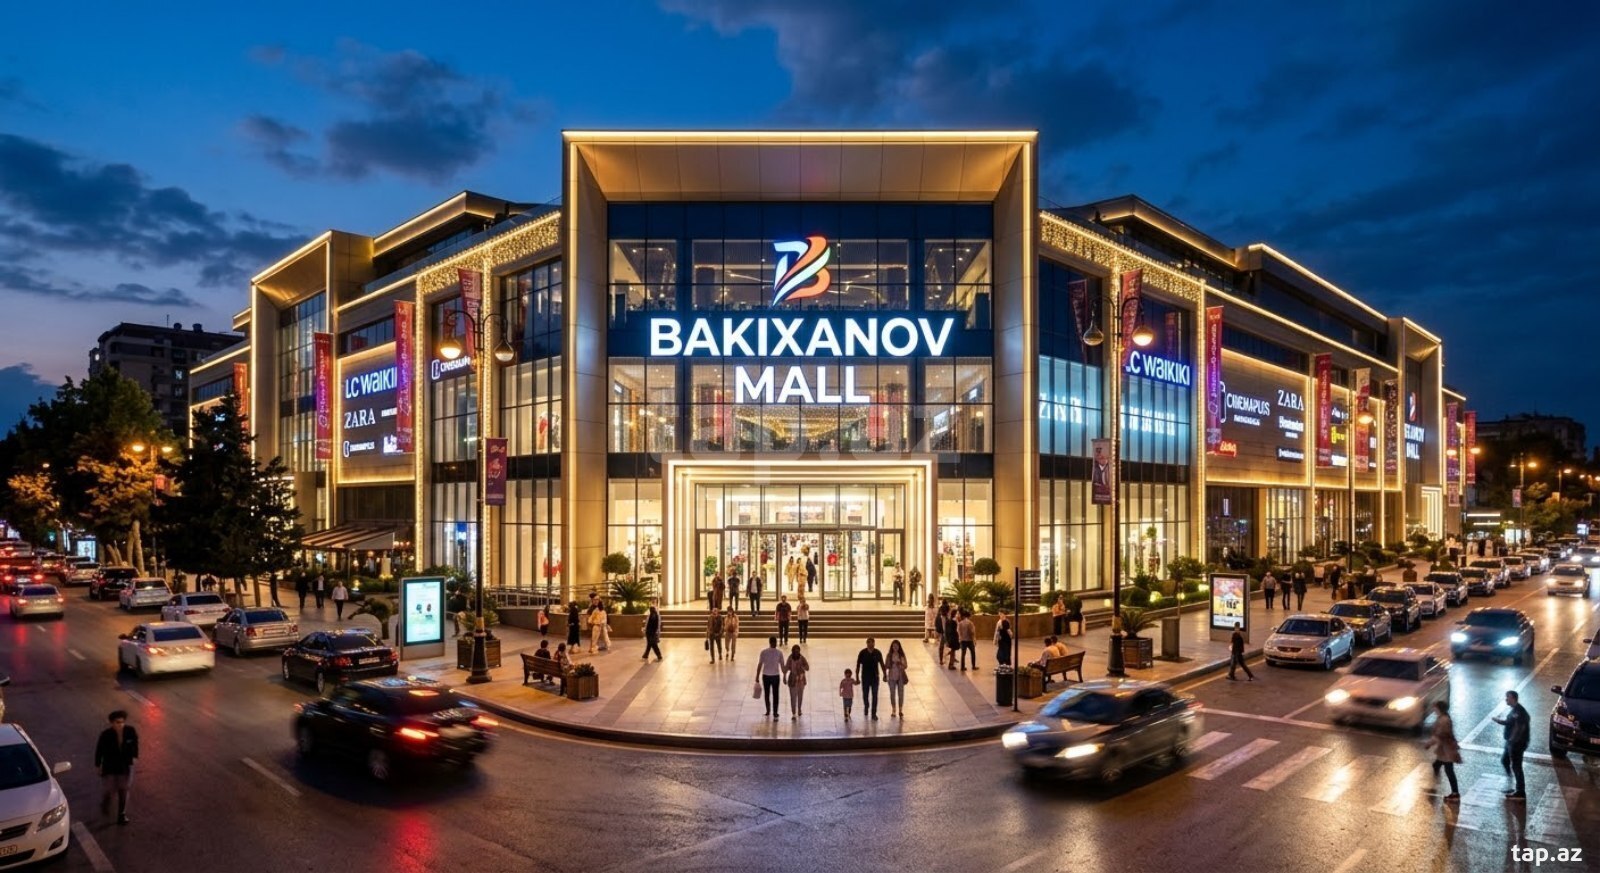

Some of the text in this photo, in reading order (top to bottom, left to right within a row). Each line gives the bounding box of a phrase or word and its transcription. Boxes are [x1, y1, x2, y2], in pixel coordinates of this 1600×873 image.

[650, 317, 954, 356] BAKIXANOV
[345, 377, 359, 398] LC
[734, 365, 870, 403] MALL
[1278, 389, 1304, 411] ZARA
[344, 408, 376, 429] ZARA
